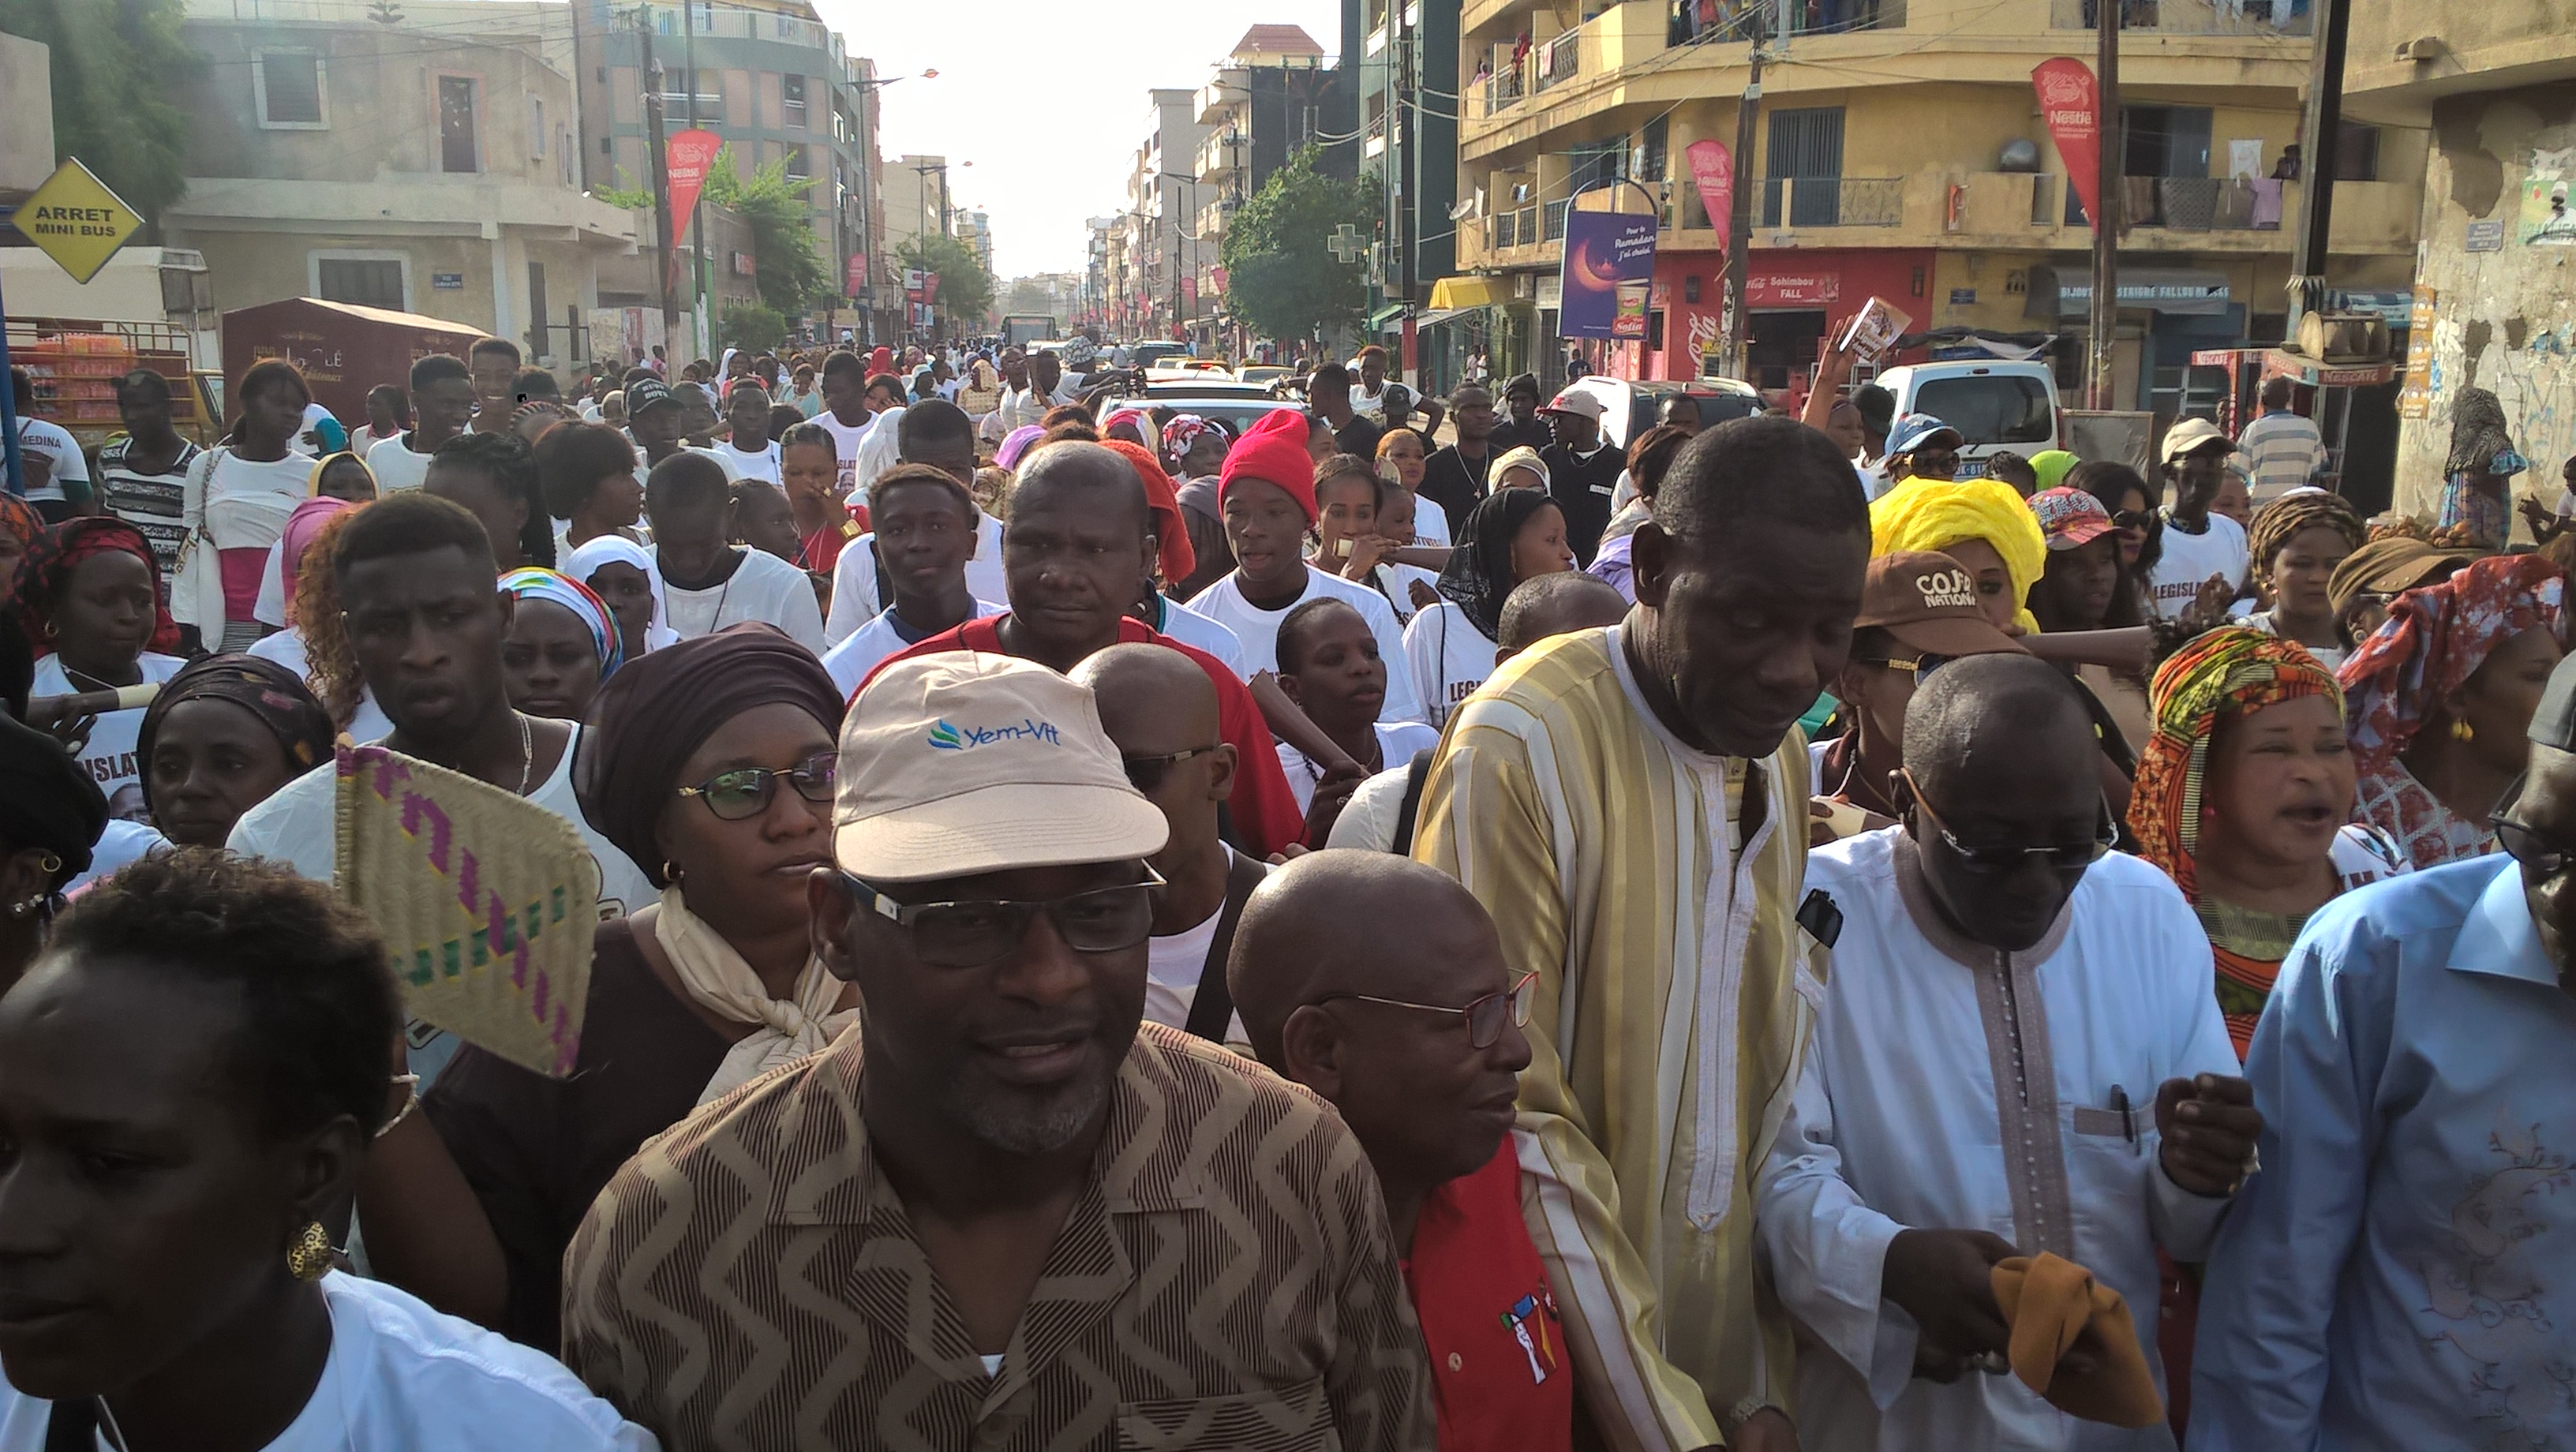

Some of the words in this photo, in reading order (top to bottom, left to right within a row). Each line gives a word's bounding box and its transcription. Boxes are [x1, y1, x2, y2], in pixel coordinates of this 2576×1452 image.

[36, 206, 114, 222] ARRET
[36, 223, 74, 234] MINI
[80, 225, 116, 237] BUS
[1626, 226, 1639, 235] Pour
[1615, 234, 1655, 249] Ramadan
[1780, 289, 1803, 298] FALL
[1402, 303, 1415, 319] 38
